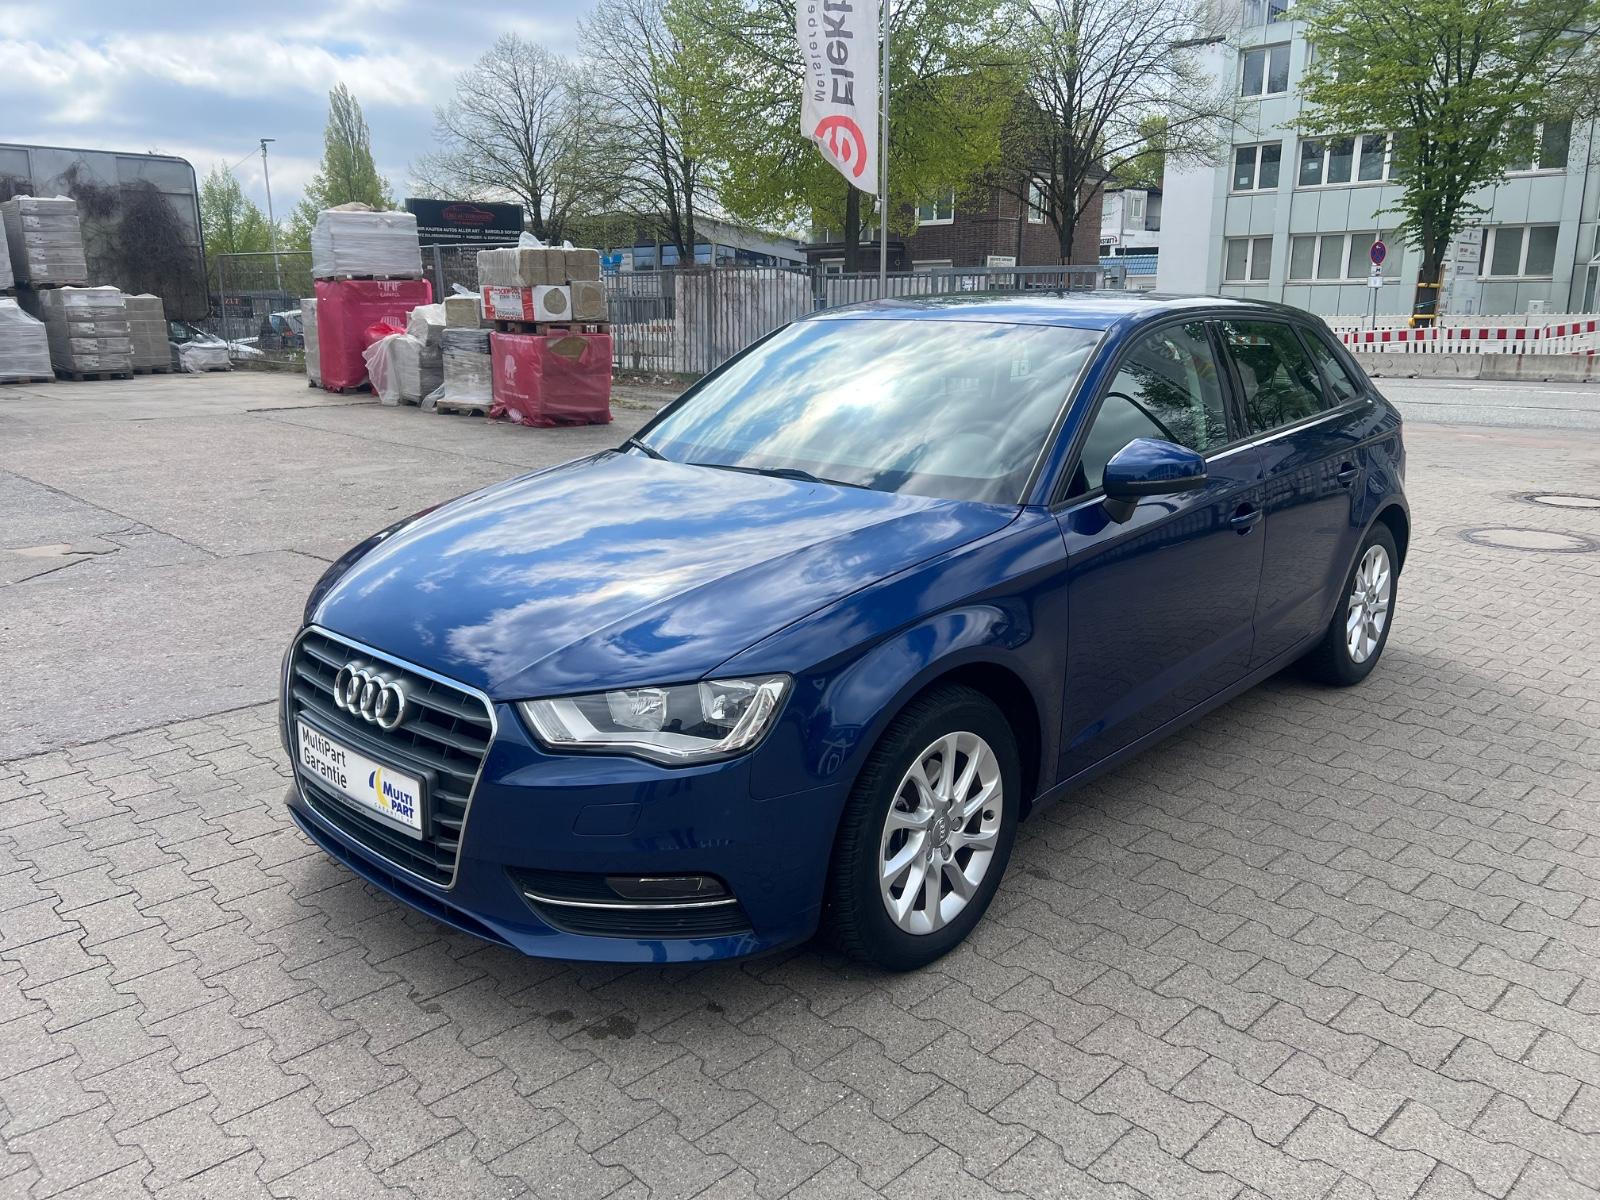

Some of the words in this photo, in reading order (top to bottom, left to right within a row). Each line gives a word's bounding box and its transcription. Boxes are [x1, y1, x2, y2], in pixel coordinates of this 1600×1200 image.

[302, 726, 347, 768] MultiPart
[303, 746, 348, 789] Garantie
[383, 780, 413, 807] MULTI
[391, 800, 415, 819] PART
